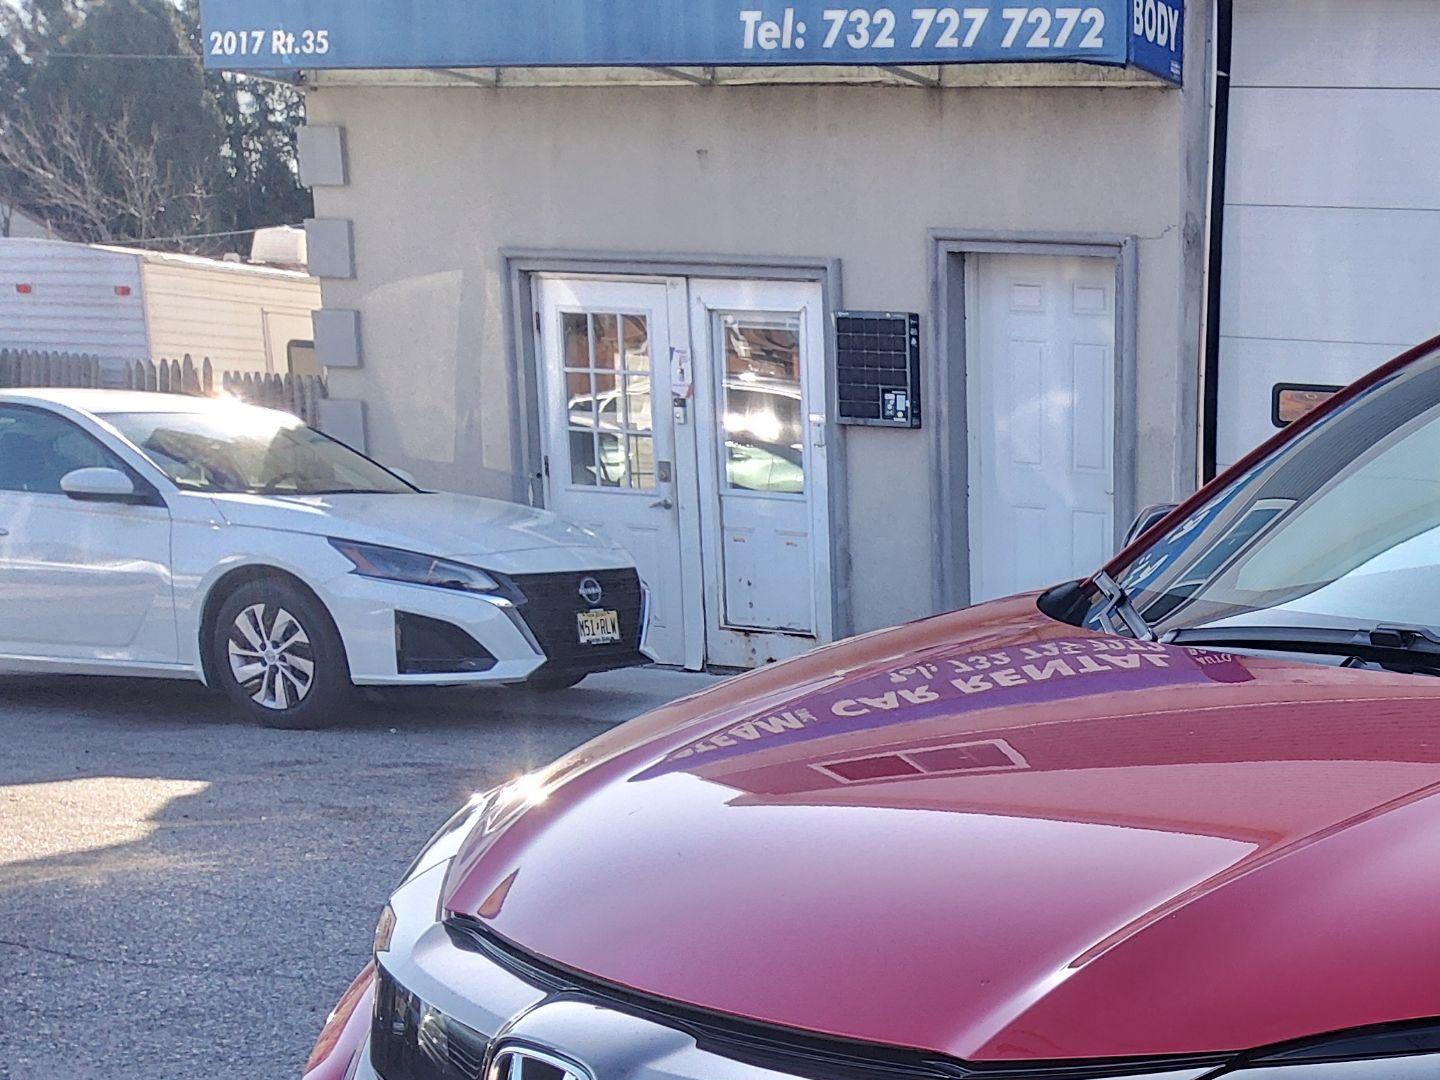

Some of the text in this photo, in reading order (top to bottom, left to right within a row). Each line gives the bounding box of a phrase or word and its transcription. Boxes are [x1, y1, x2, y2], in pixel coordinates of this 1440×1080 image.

[210, 29, 329, 55] 2017 Rt.35
[739, 7, 1105, 50] Tel: 732 727 7272
[1133, 0, 1179, 52] BODY
